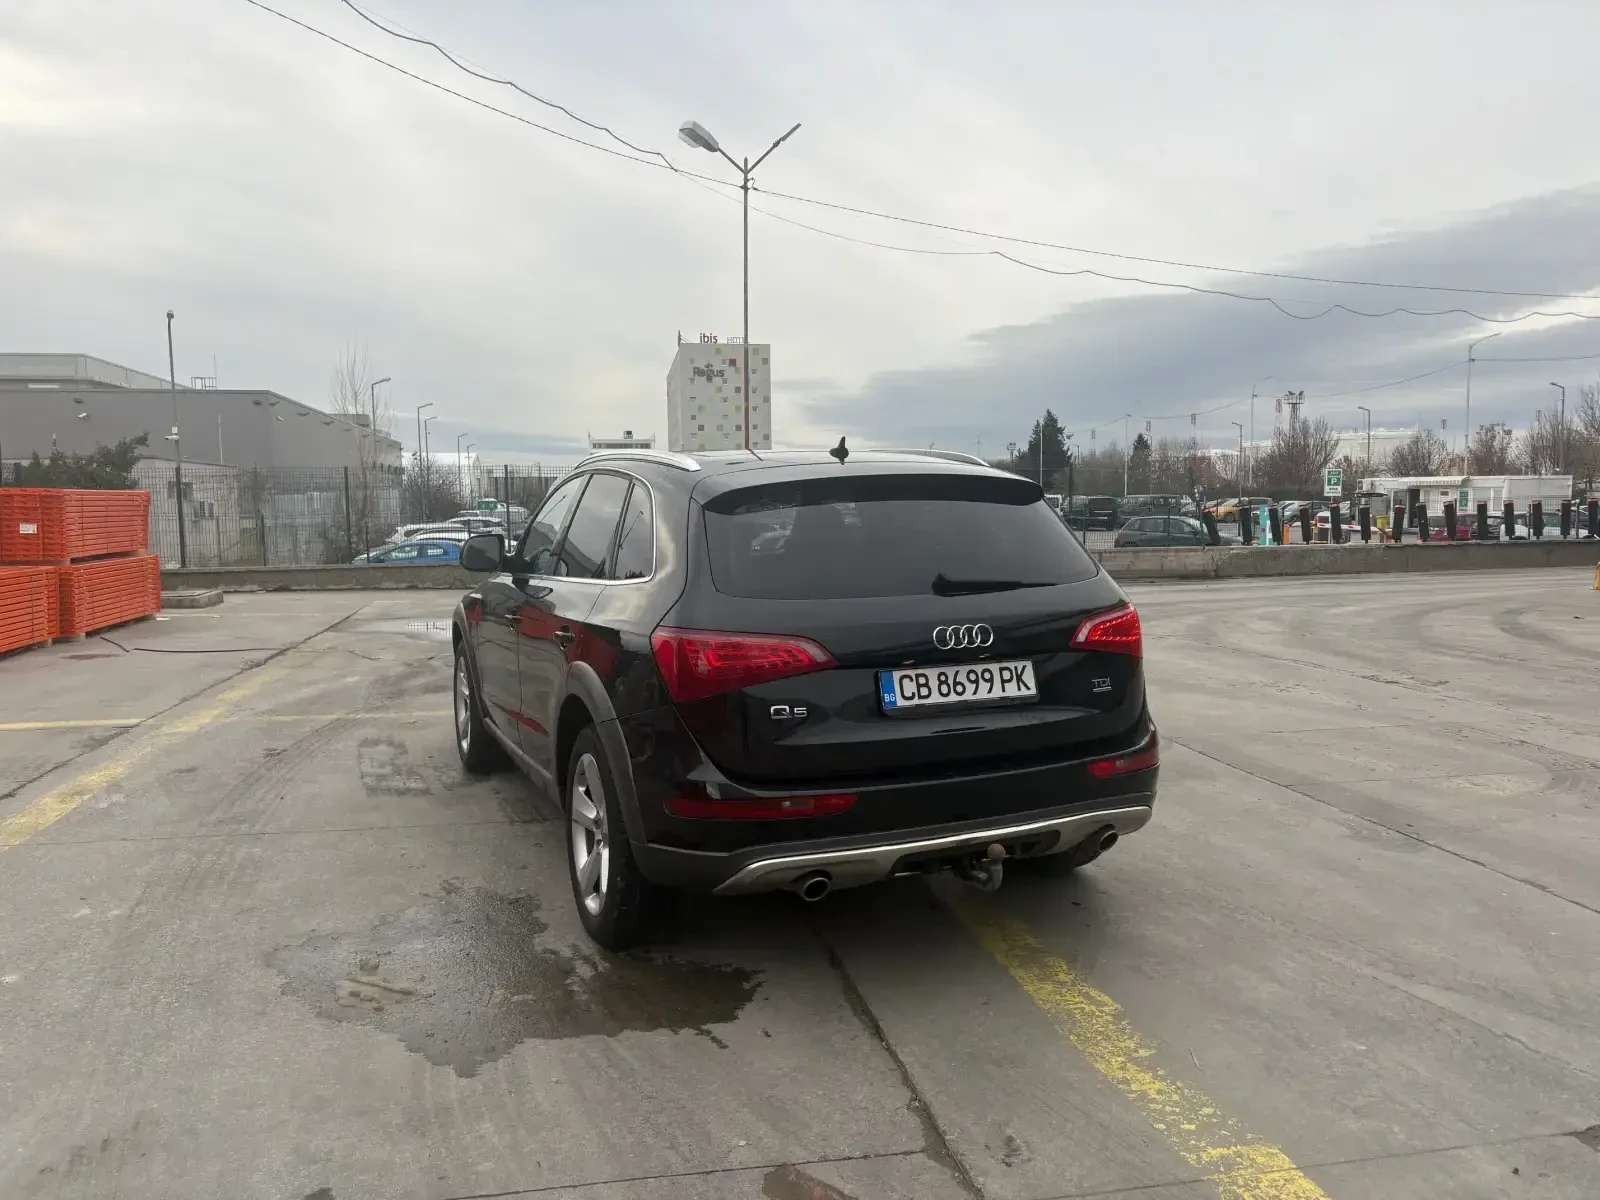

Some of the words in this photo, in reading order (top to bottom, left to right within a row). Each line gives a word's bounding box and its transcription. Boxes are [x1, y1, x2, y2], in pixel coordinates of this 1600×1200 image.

[699, 332, 718, 344] ibis
[898, 672, 933, 701] CB
[936, 667, 994, 698] 8699
[998, 664, 1031, 693] PK
[1091, 678, 1111, 688] TDI
[884, 693, 896, 702] BG
[770, 705, 807, 720] Q5
